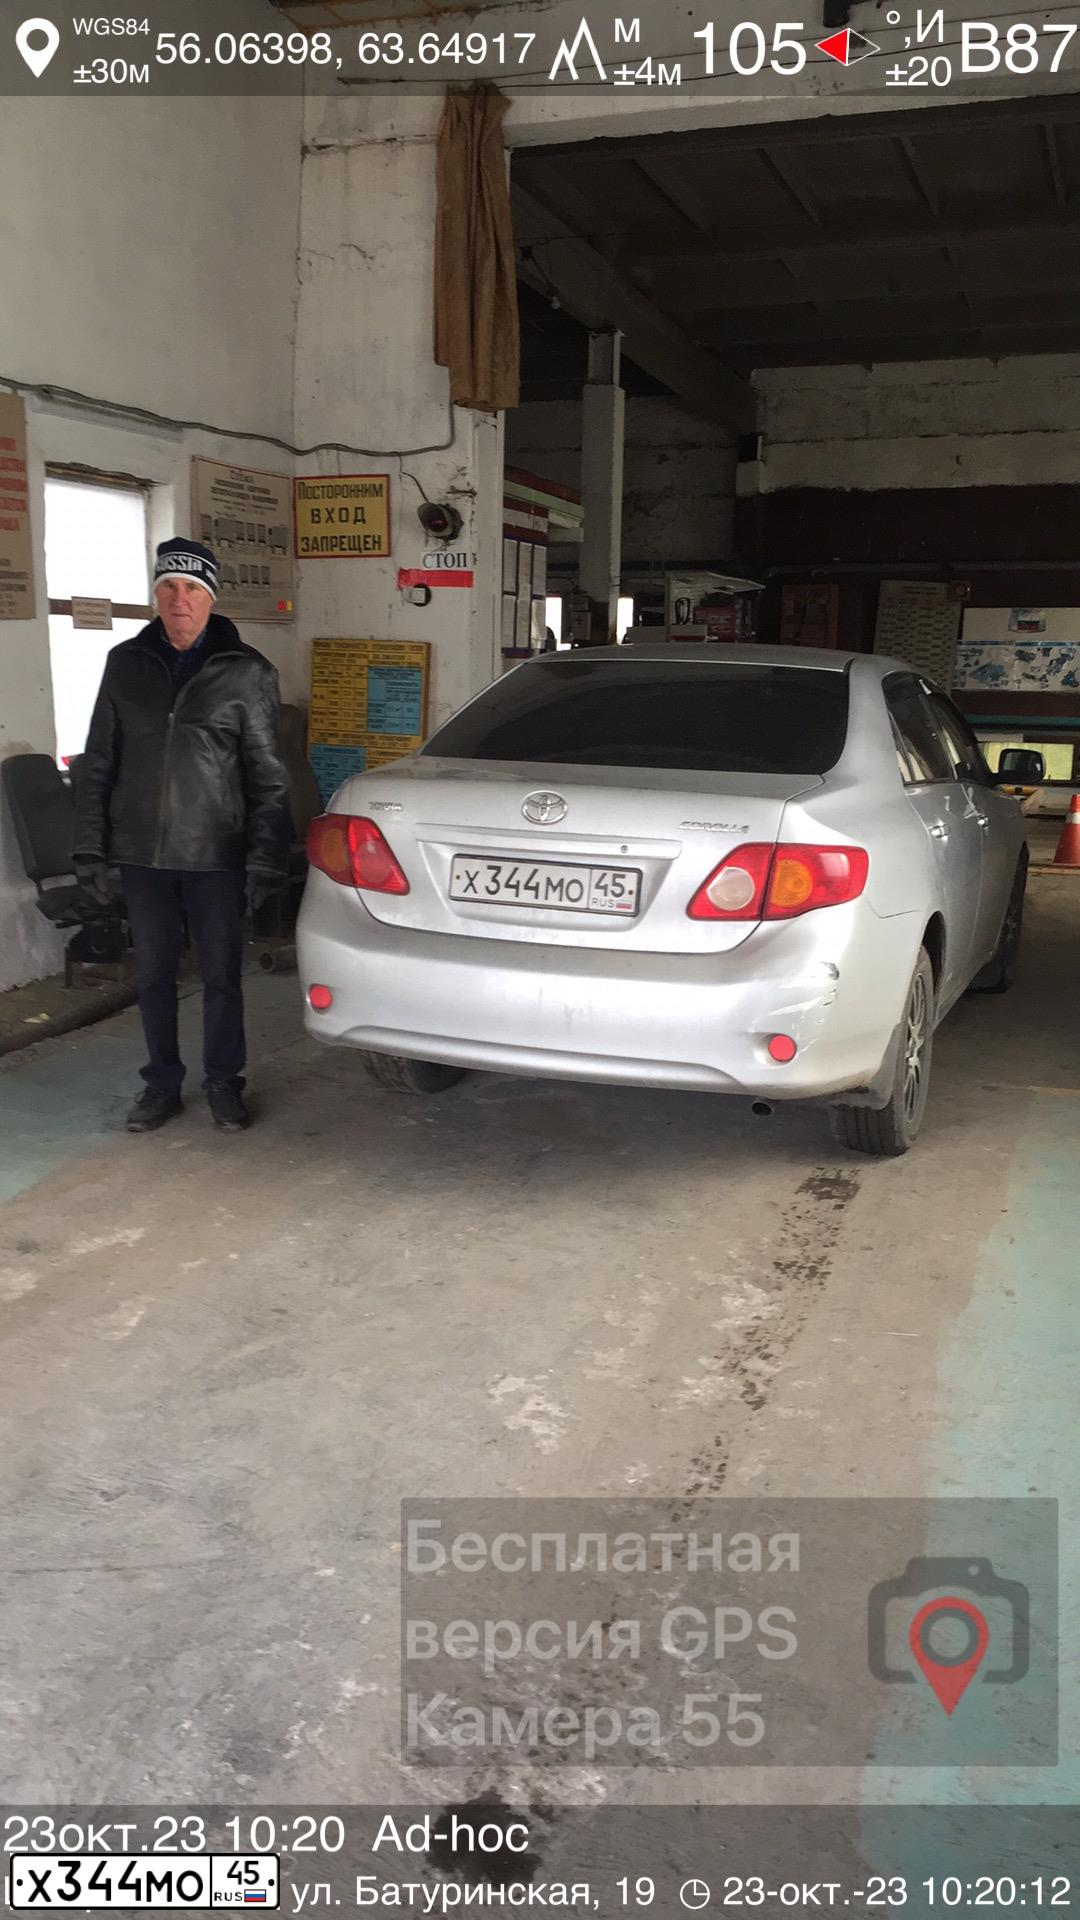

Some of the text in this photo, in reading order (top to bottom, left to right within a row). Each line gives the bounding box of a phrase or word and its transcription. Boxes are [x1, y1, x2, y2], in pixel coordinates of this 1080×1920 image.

[311, 506, 366, 525] ВХОД
[301, 534, 381, 553] ЗАПРЕЩЕН
[423, 552, 467, 569] СТОП
[594, 872, 626, 898] 45
[591, 898, 615, 909] RUS
